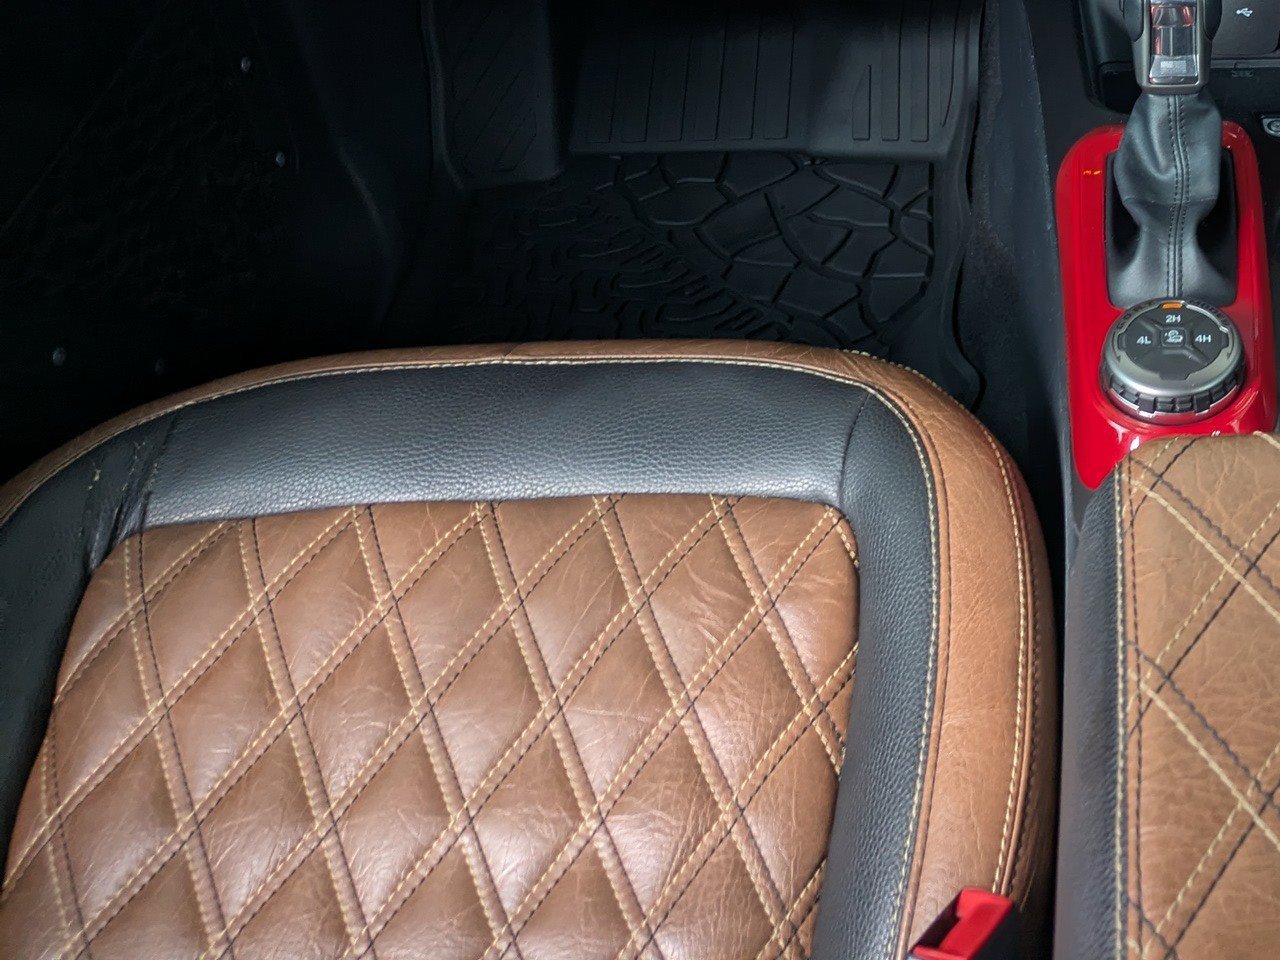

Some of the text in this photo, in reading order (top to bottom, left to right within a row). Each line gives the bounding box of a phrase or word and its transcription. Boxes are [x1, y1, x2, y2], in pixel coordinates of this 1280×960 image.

[1165, 314, 1182, 323] 2H
[1136, 336, 1152, 344] 4L
[1194, 334, 1212, 343] 4H
